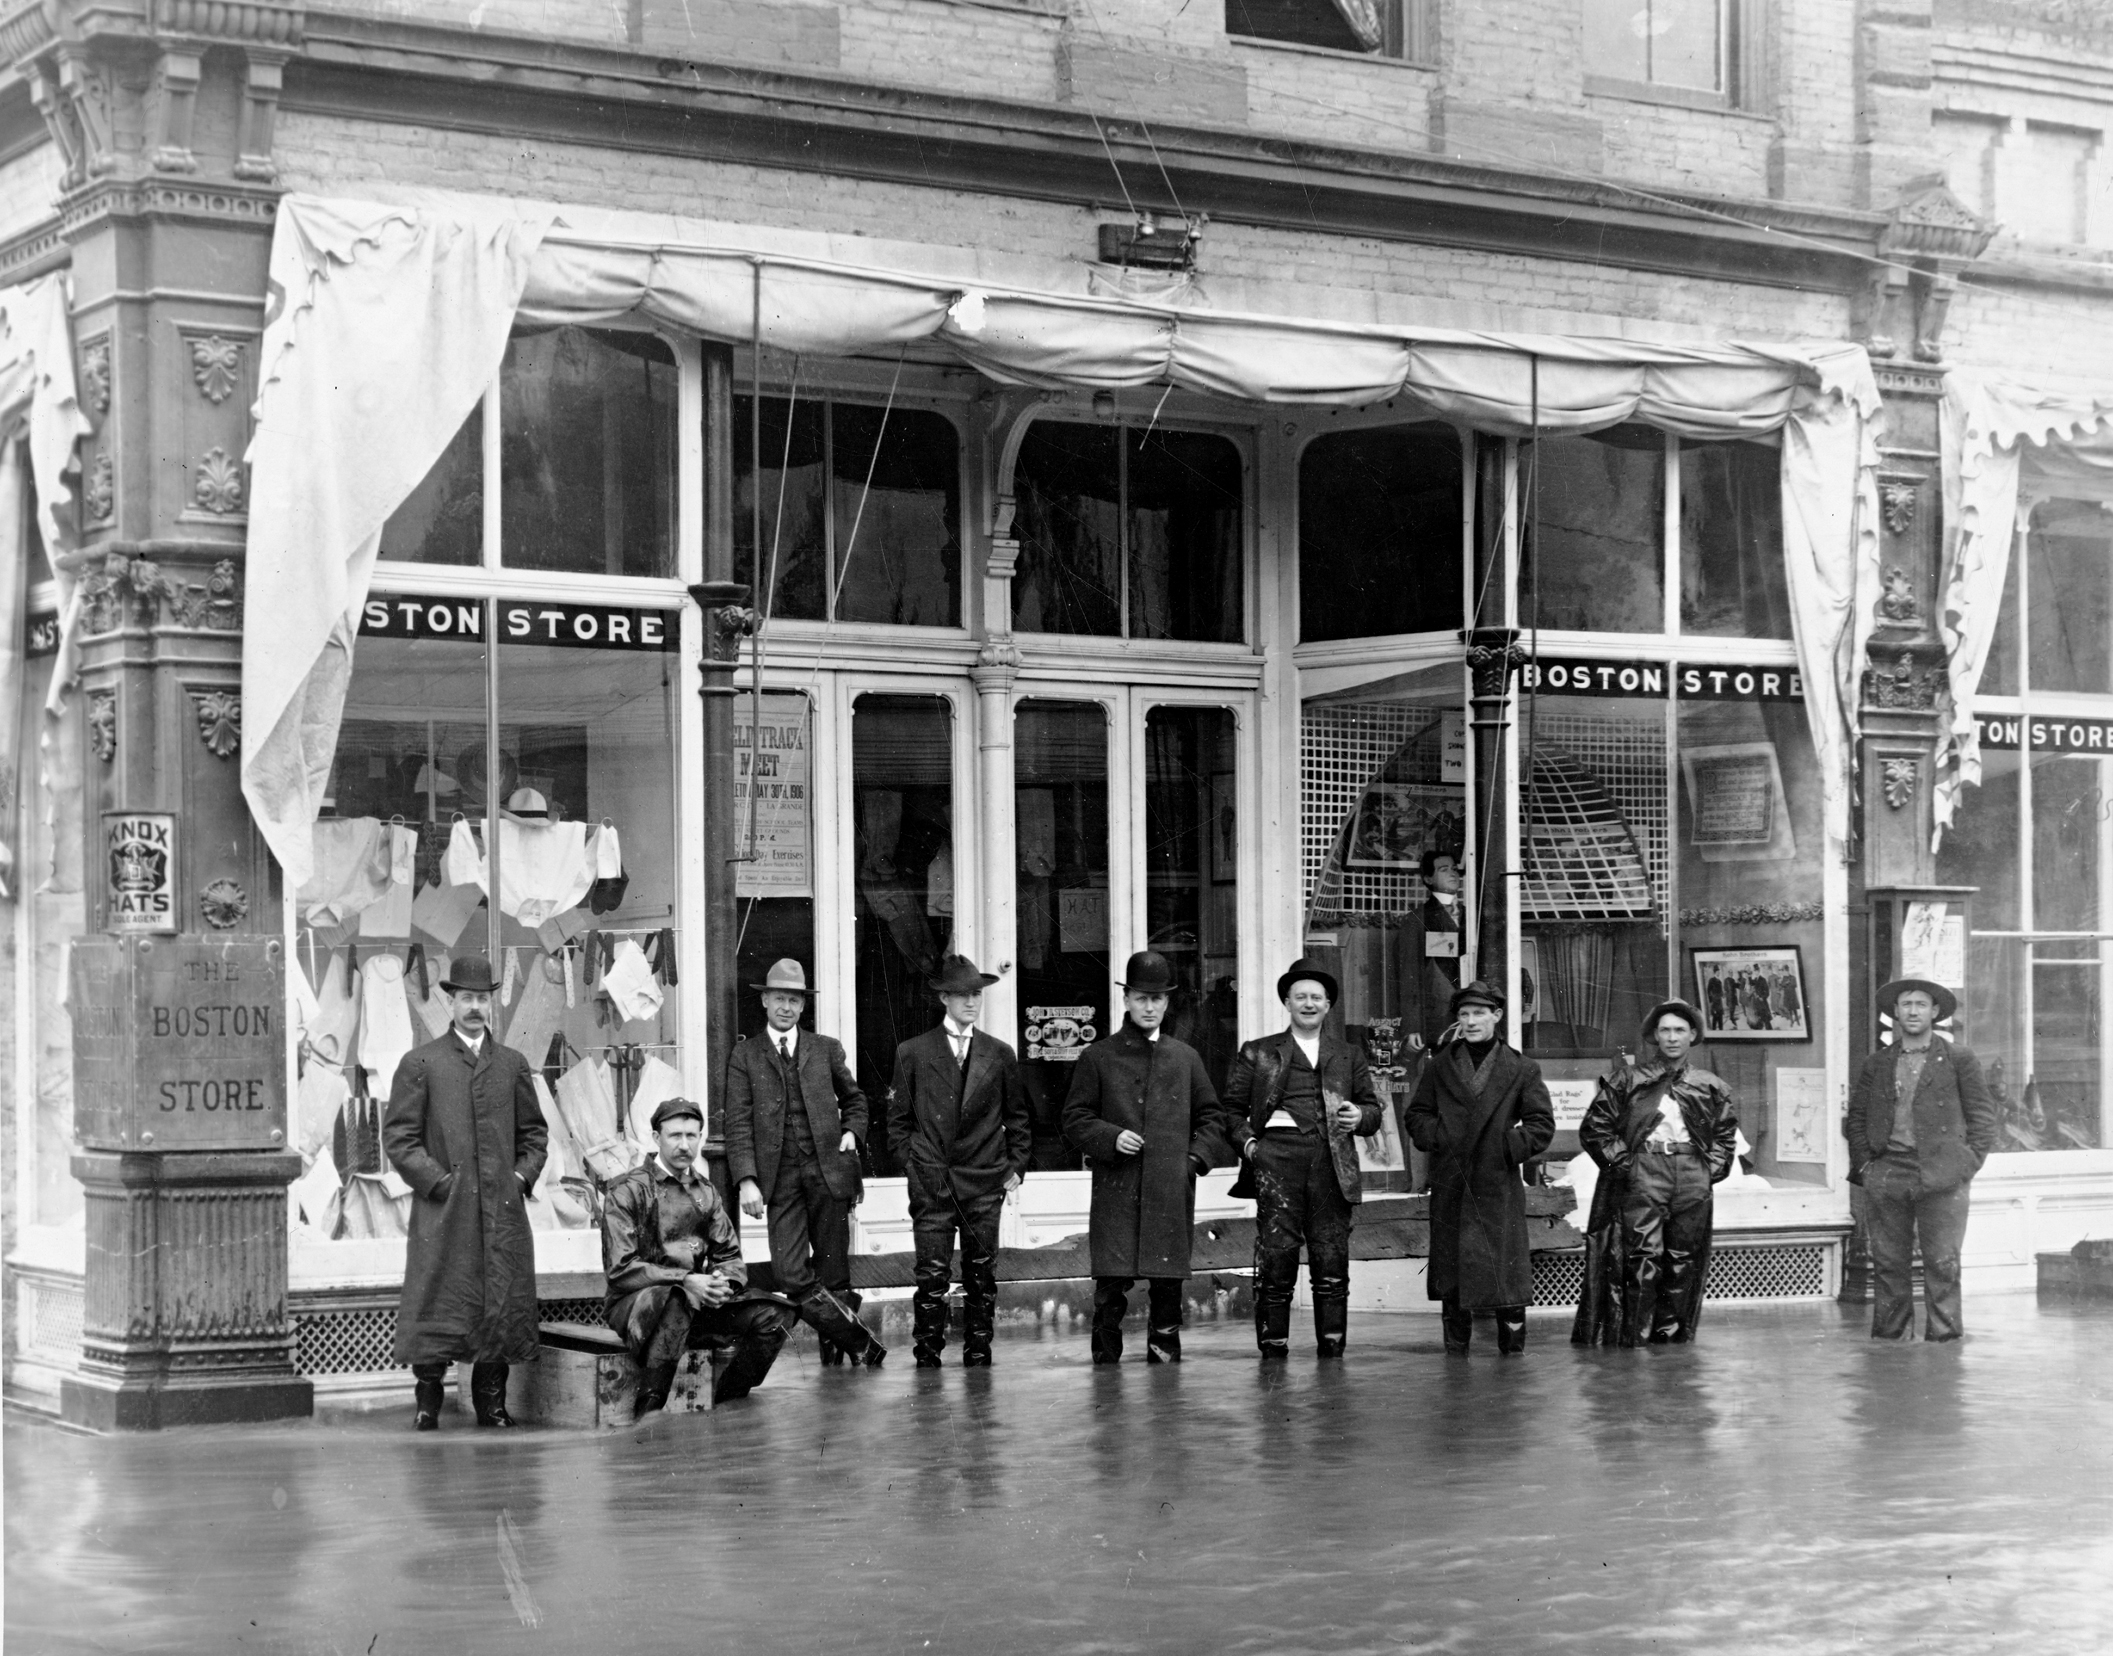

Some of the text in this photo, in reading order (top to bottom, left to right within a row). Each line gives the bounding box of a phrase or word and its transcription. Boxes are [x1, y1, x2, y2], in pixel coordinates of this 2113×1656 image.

[364, 601, 664, 644] STON STORE
[1523, 663, 1804, 696] BOSTON STORE
[758, 726, 803, 750] TRACK
[790, 784, 804, 799] 1906
[108, 820, 168, 849] KNOX
[772, 849, 804, 860] Exercises
[108, 893, 169, 912] HATS
[184, 962, 240, 981] THE
[153, 1005, 270, 1037] BOSTON
[1368, 1016, 1402, 1027] AGENCY
[159, 1079, 272, 1112] STORE.
[1385, 1081, 1410, 1093] HATS
